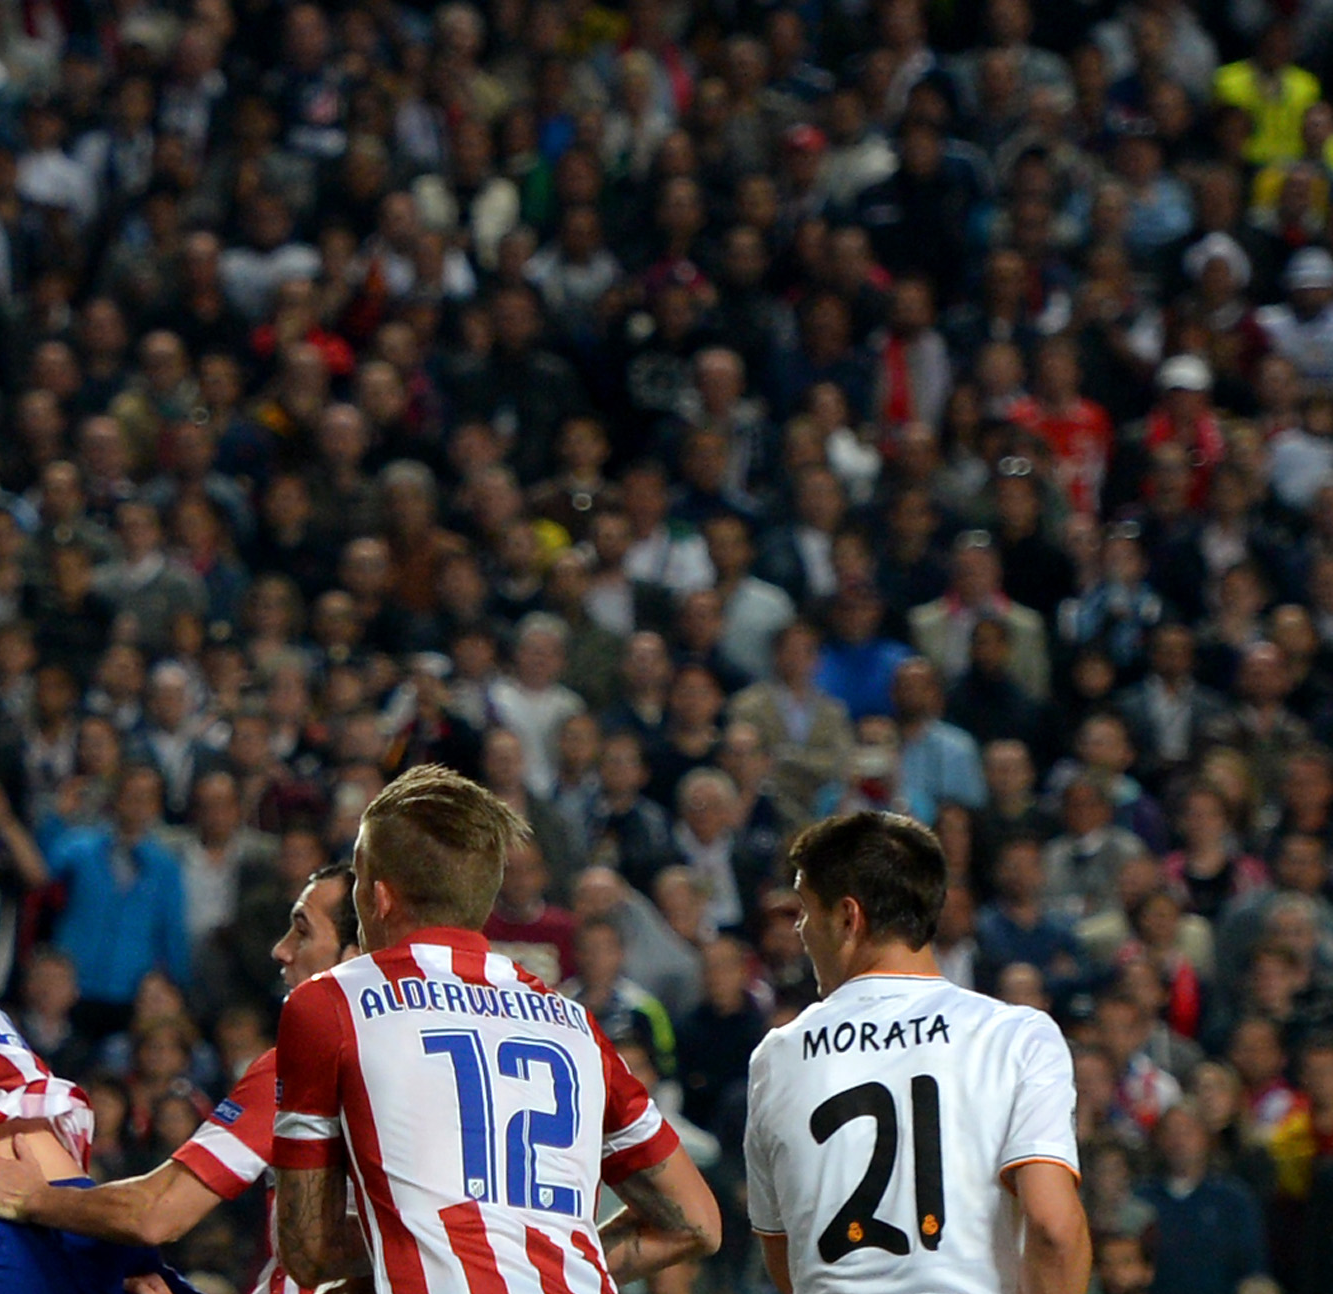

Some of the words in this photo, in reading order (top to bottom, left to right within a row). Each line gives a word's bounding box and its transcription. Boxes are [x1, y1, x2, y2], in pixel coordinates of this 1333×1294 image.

[359, 978, 590, 1036] ALDERWEIRELD
[802, 1014, 950, 1060] MORATA
[420, 1028, 582, 1218] 12
[810, 1074, 945, 1264] 21
